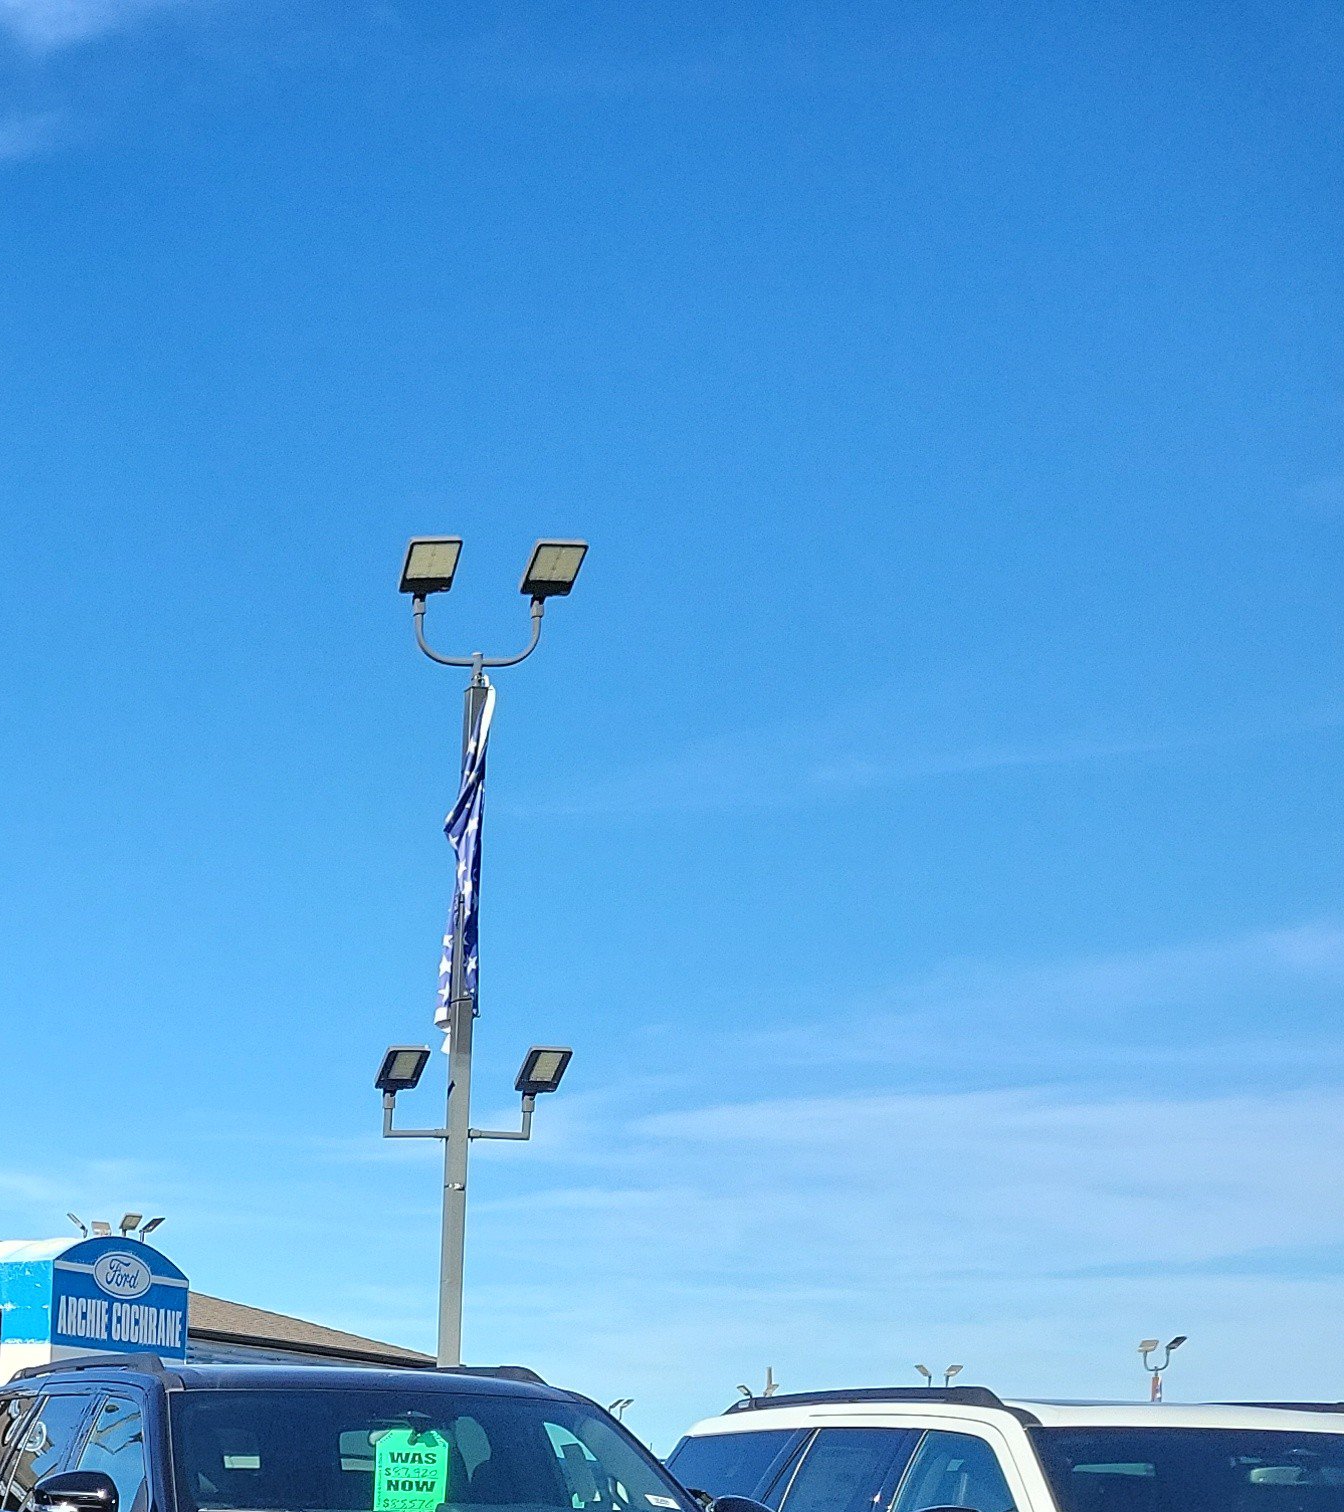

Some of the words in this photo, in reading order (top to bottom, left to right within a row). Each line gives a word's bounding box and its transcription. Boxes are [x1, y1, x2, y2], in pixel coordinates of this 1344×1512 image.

[105, 1258, 140, 1289] Ford
[57, 1295, 109, 1340] ARCHIE
[112, 1302, 182, 1348] COCHRANE
[389, 1452, 437, 1464] WAS
[386, 1480, 436, 1492] NOW
